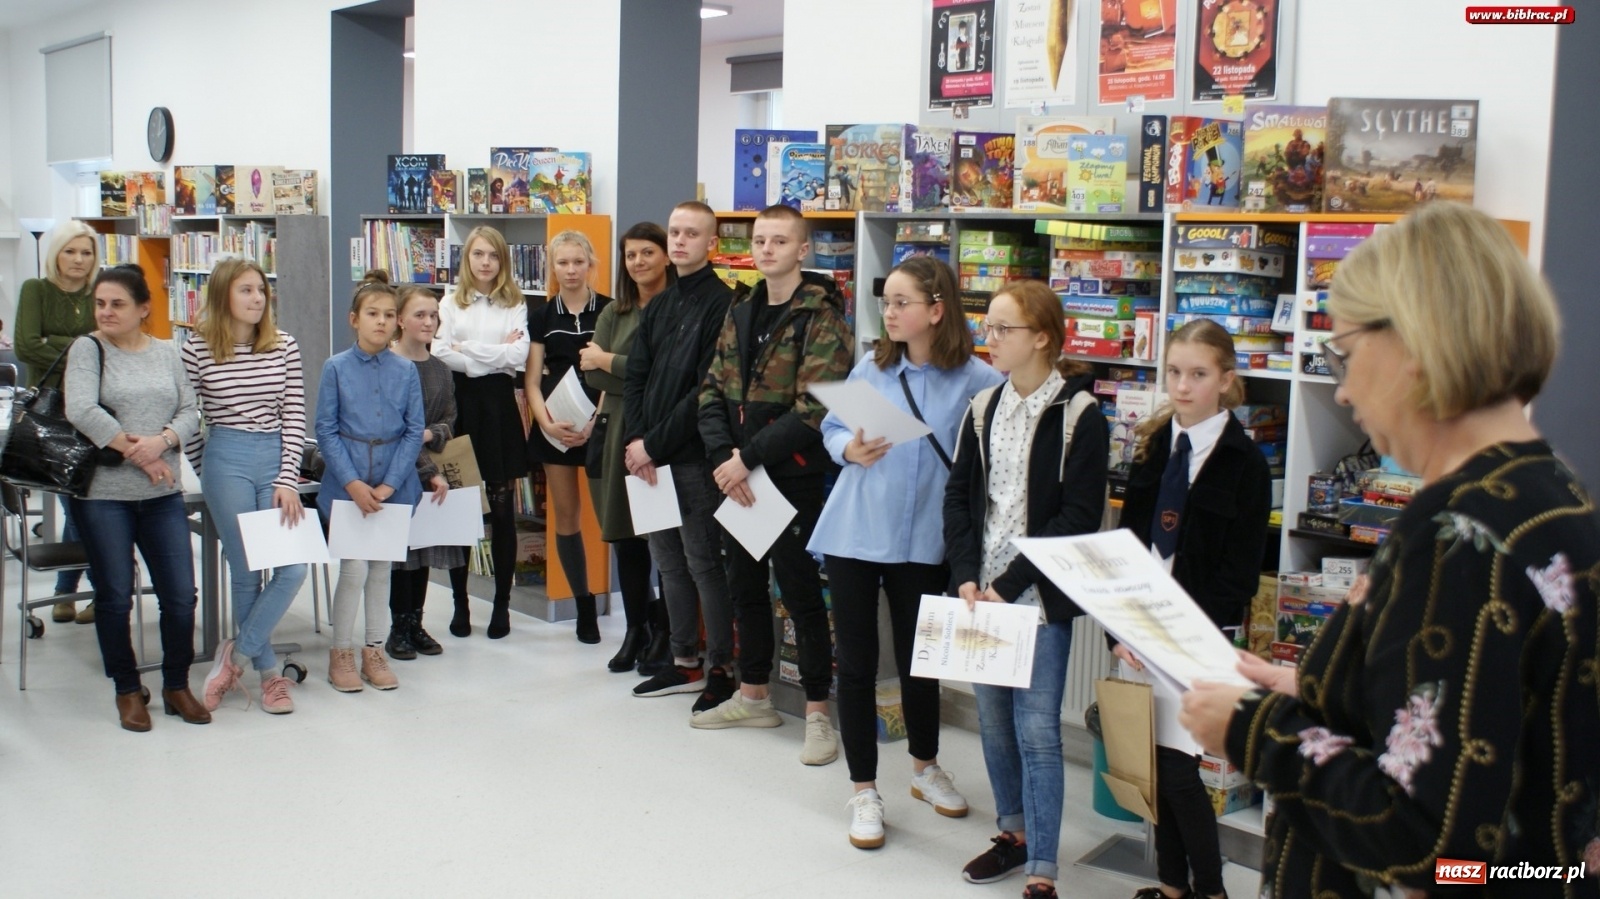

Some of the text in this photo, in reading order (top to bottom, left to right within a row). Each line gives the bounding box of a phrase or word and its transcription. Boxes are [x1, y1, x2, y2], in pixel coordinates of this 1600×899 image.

[1212, 64, 1256, 76] 22 listopada
[1023, 139, 1036, 147] 188
[394, 156, 428, 168] XCOM
[1072, 192, 1085, 200] 403
[1248, 185, 1264, 196] 247
[1187, 228, 1230, 240] GOOOL!
[423, 239, 435, 249] 36
[1338, 566, 1352, 575] 255
[917, 611, 937, 661] Dyplom
[941, 610, 955, 666] Nicola Sobiech
